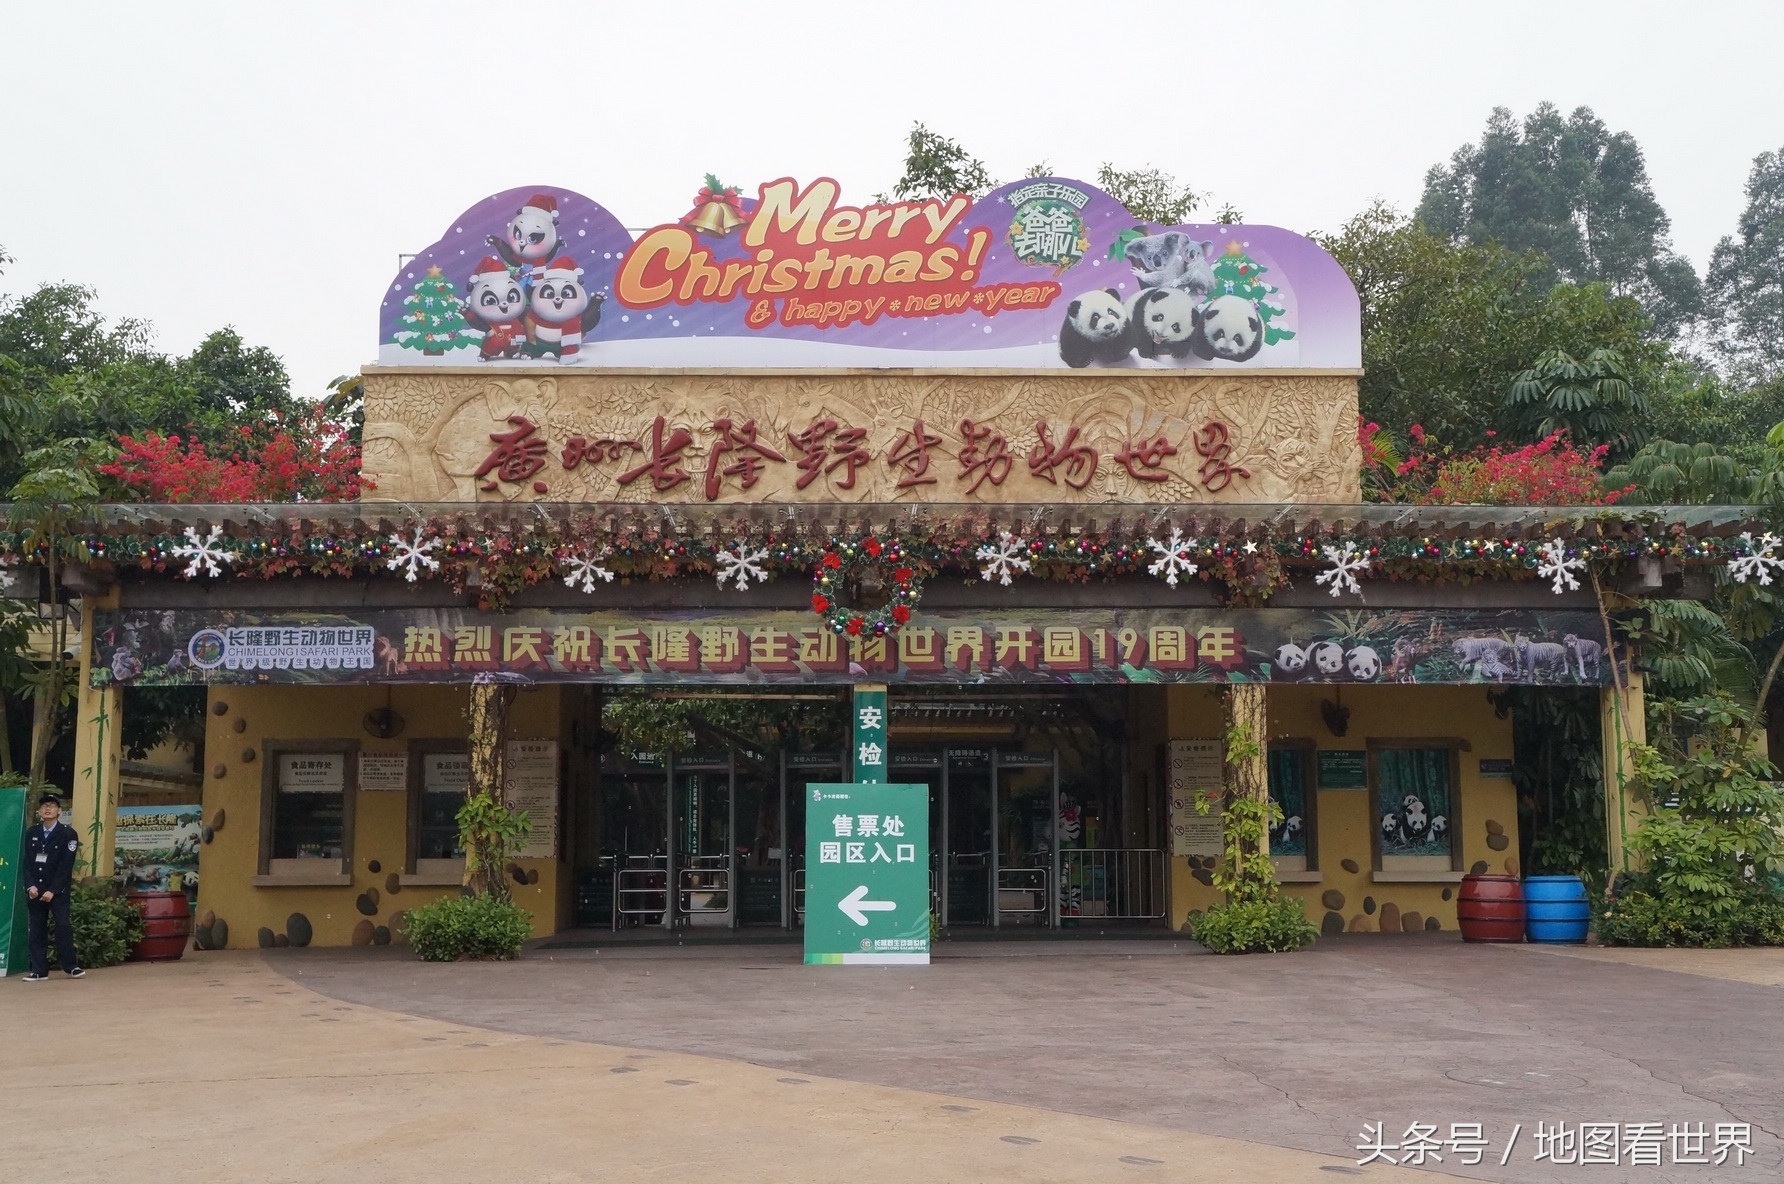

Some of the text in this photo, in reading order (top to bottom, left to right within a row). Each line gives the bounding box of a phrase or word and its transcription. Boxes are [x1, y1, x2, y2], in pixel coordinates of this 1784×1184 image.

[1007, 183, 1089, 209] 指定亲子乐园
[745, 181, 968, 246] Merry
[1021, 205, 1073, 233] 爸爸
[619, 228, 988, 304] Christmas!
[751, 285, 1056, 324] & happy new year
[228, 630, 372, 646] 长隆野生动物世界
[404, 625, 1235, 663] 热烈庆祝长隆野生动物世界开园19周年
[228, 648, 371, 656] CHIMELONG SAFARI PARK
[229, 657, 371, 666] 世界级野生动物王国
[859, 706, 883, 784] 安检
[291, 761, 332, 770] 食品寄存处
[983, 753, 989, 761] 3
[832, 814, 905, 837] 售票处
[820, 841, 915, 863] 园区入口
[874, 939, 926, 947] 长隆野生动物世界
